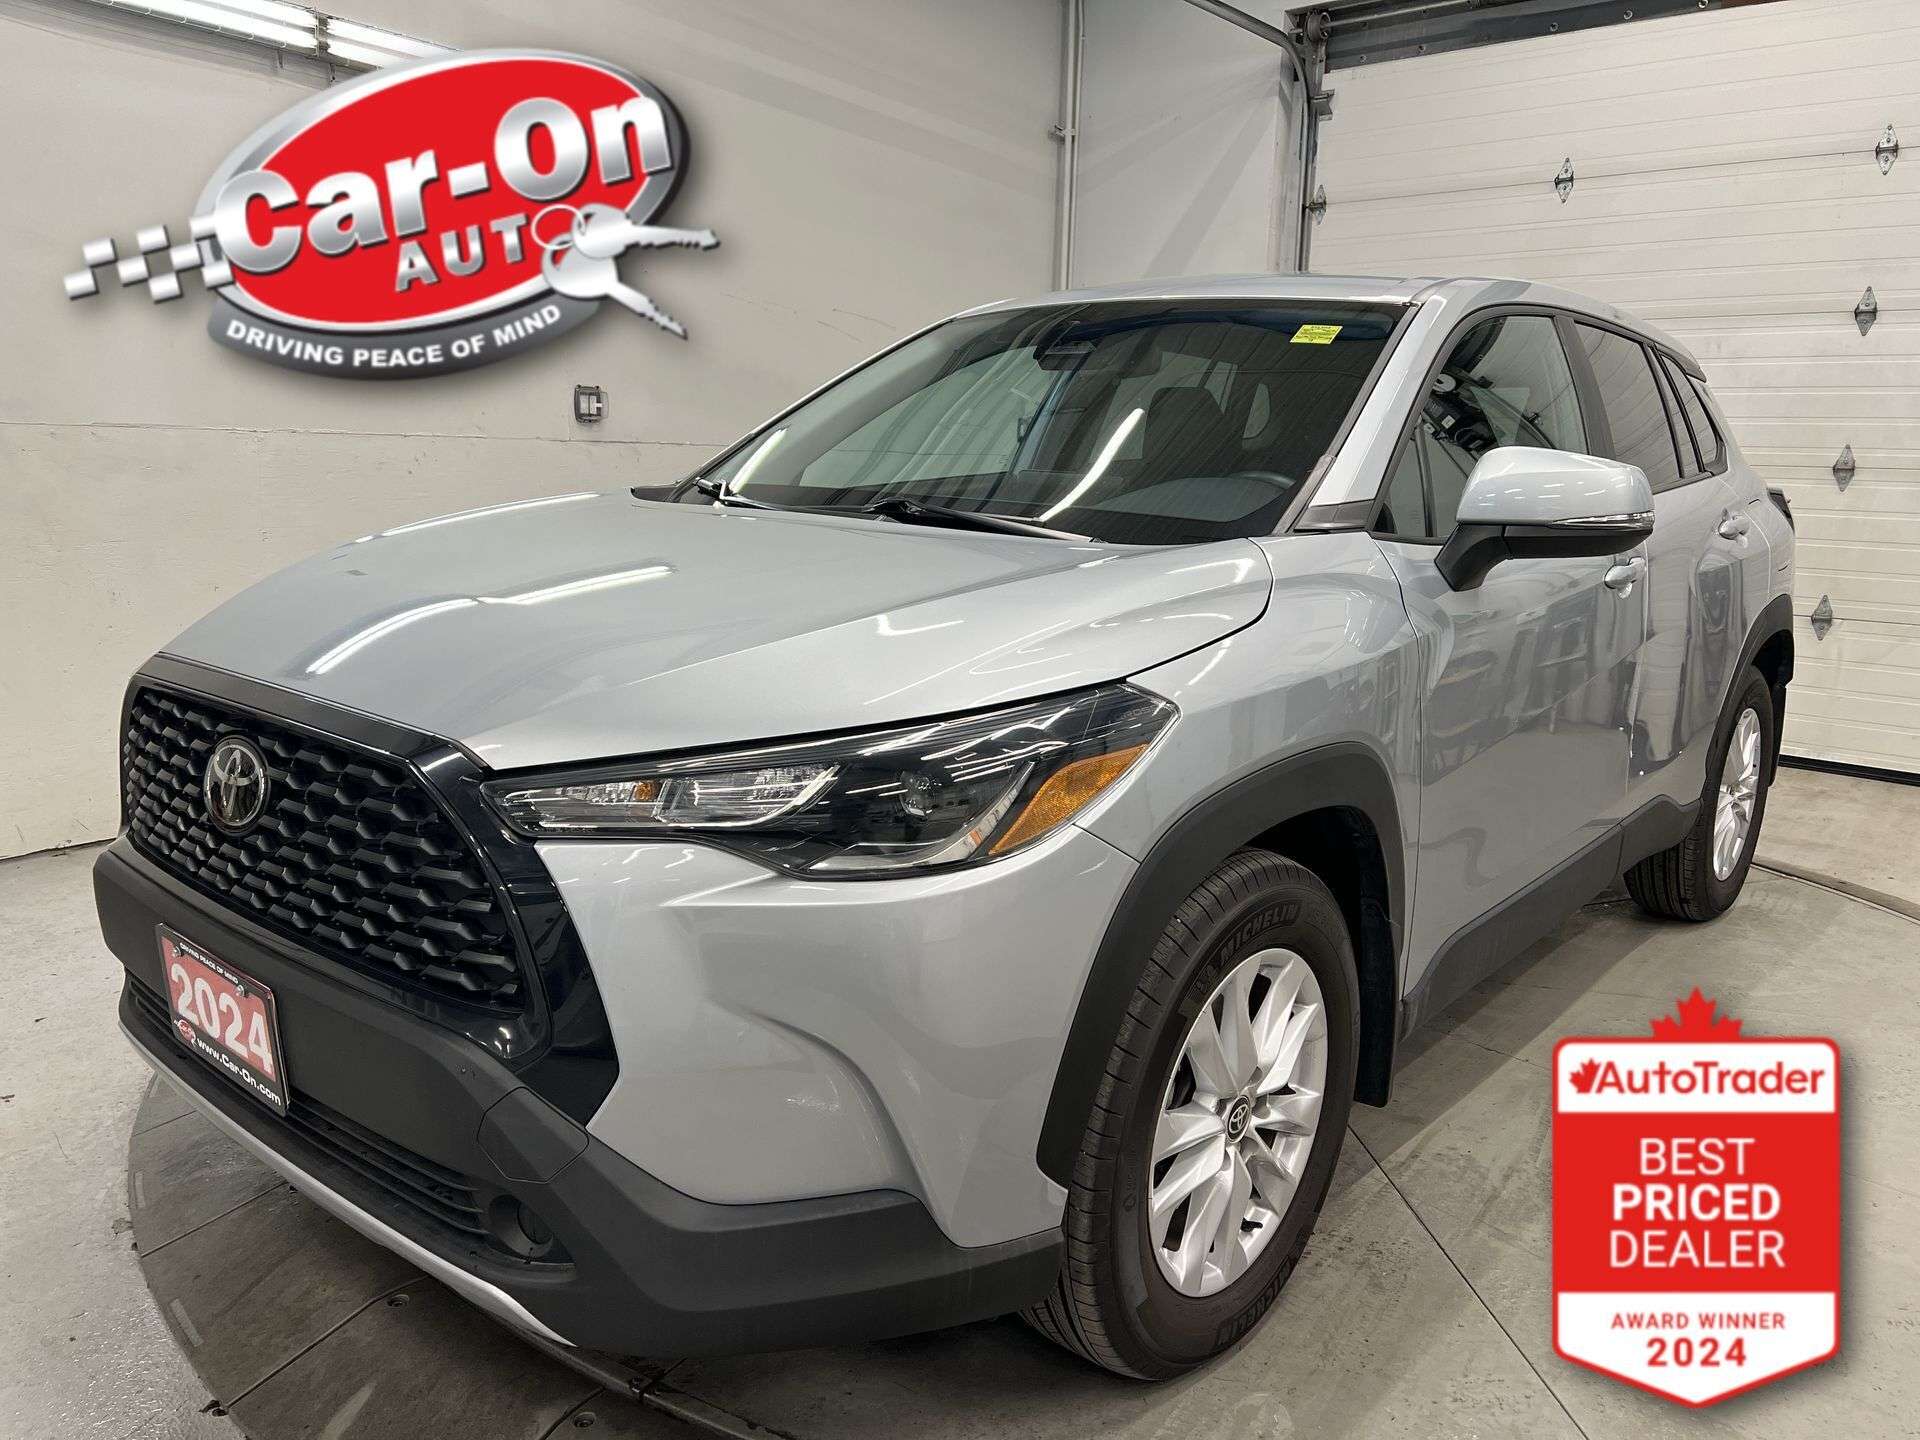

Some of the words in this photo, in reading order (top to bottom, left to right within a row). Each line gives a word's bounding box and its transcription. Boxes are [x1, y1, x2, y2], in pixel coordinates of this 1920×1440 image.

[1220, 903, 1299, 964] MICHELIN
[171, 963, 273, 1075] 2024
[197, 1038, 281, 1106] www.Car-On.com
